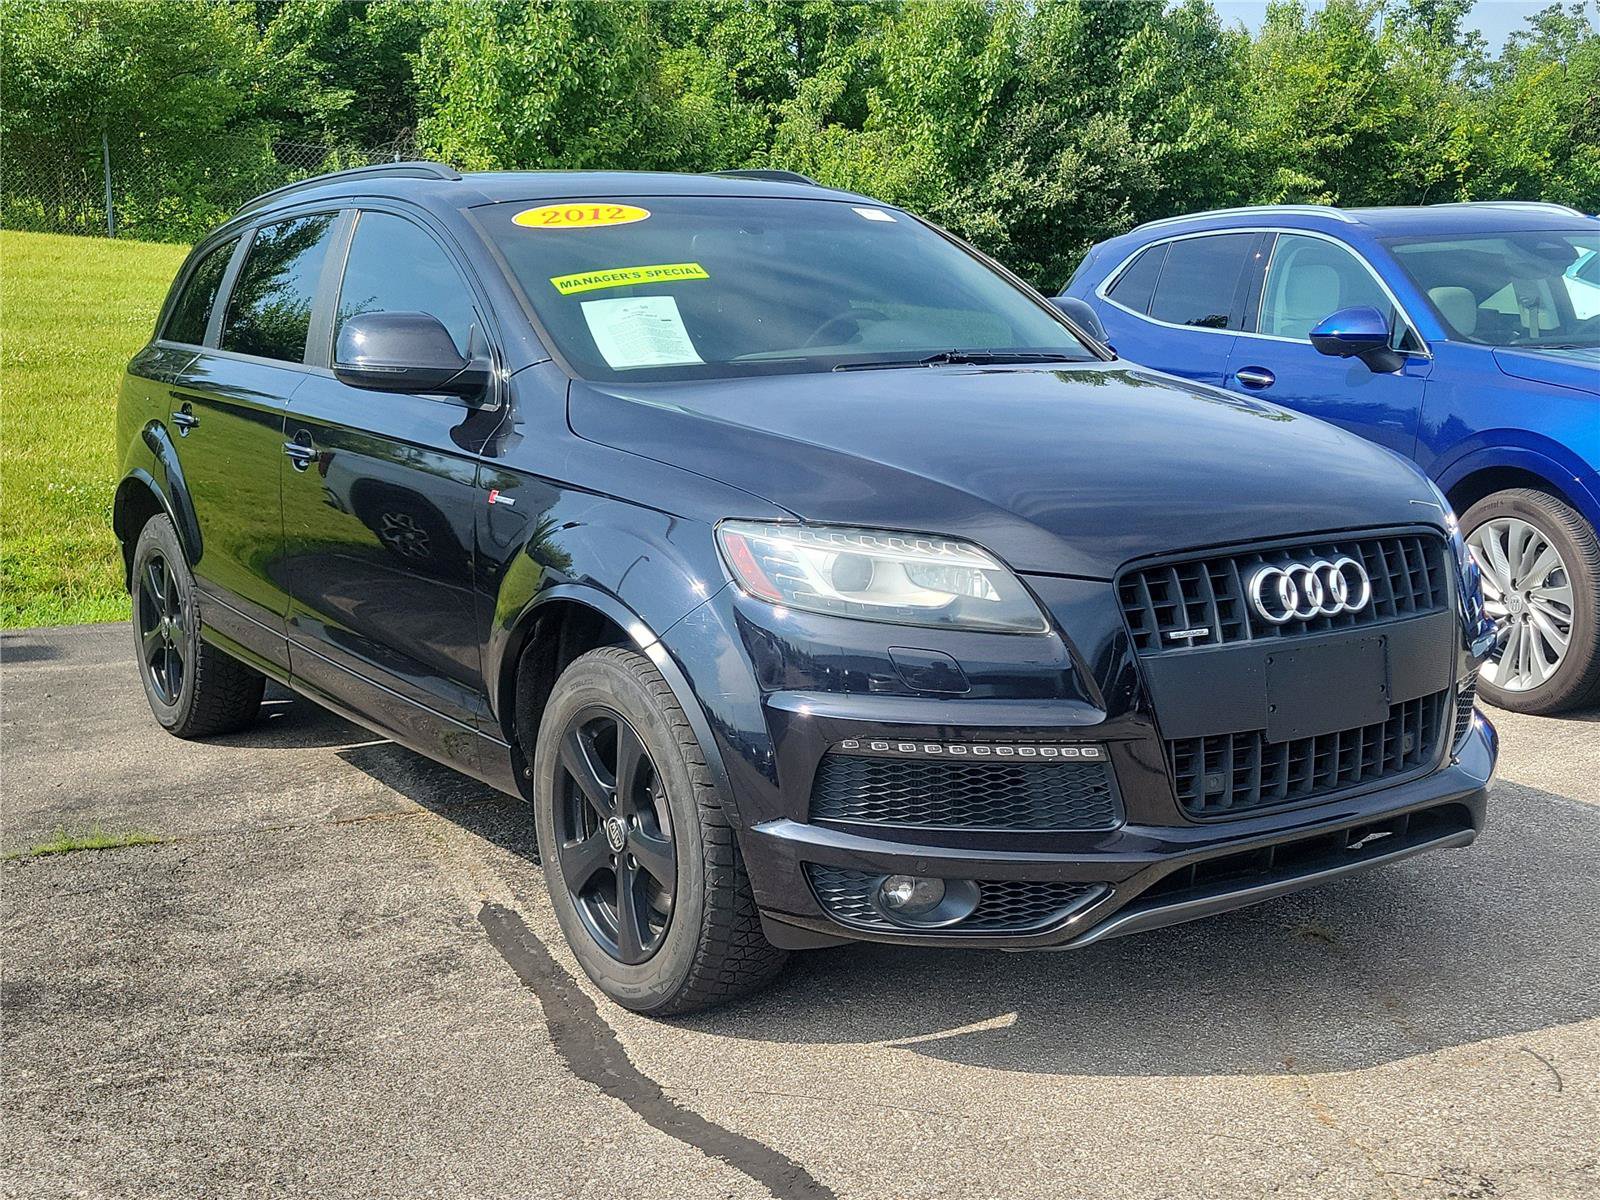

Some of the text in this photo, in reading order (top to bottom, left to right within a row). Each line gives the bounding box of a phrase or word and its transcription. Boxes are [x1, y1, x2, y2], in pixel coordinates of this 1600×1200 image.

[541, 207, 625, 225] 2012
[559, 267, 703, 289] MANAGER'S SPECIAL
